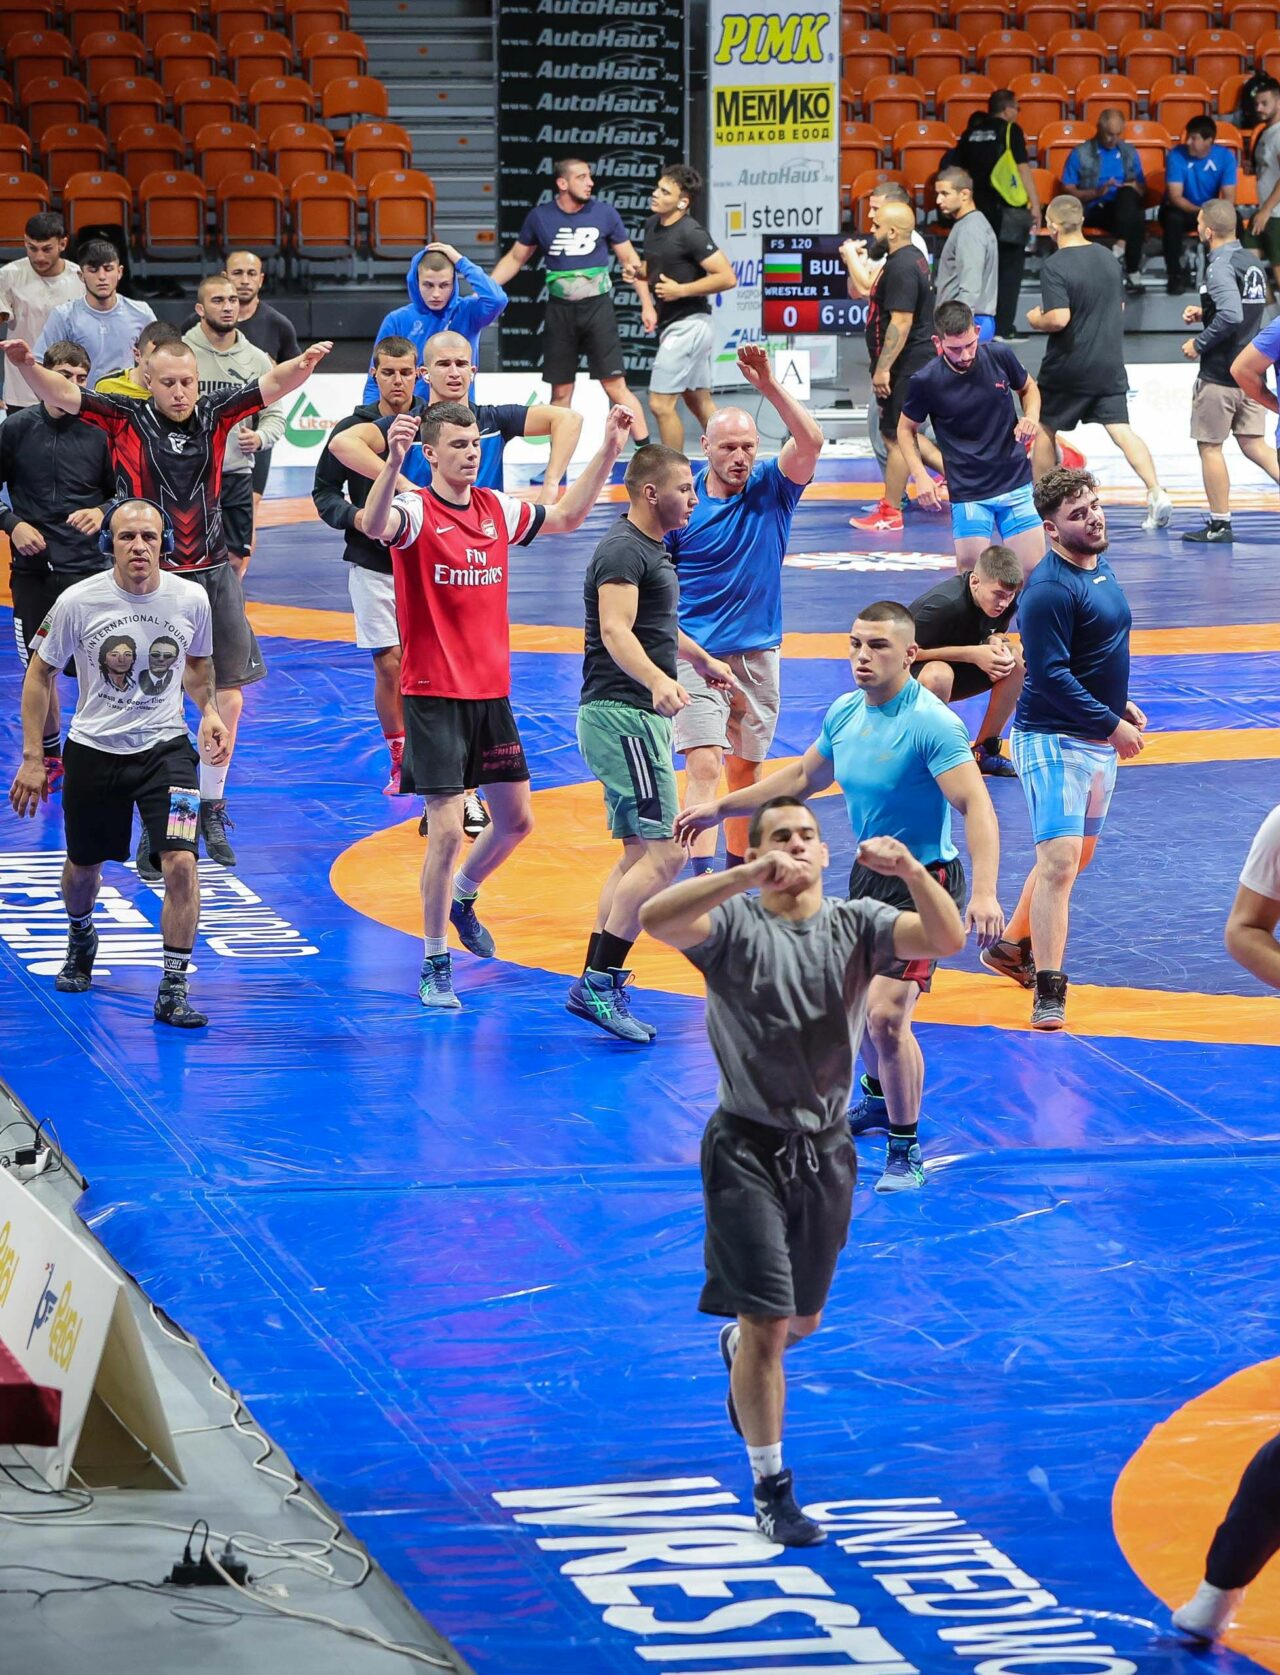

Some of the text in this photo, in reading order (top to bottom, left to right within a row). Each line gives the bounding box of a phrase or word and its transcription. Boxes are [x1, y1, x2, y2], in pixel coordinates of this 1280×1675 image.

[714, 13, 830, 65] PIMK
[716, 128, 830, 143] ЧОЛАКОВ ЕООД
[752, 205, 823, 229] stenor
[771, 238, 812, 249] FS 120
[810, 259, 845, 275] BUL
[764, 286, 817, 296] WRESTLER
[823, 286, 830, 296] 1
[783, 306, 798, 327] 0
[781, 360, 803, 384] A
[465, 548, 487, 566] Fly
[434, 564, 503, 586] Emirates
[88, 614, 160, 650] INTERNATIONAL
[198, 907, 320, 958] WORLD
[801, 1497, 1058, 1617] UNITED
